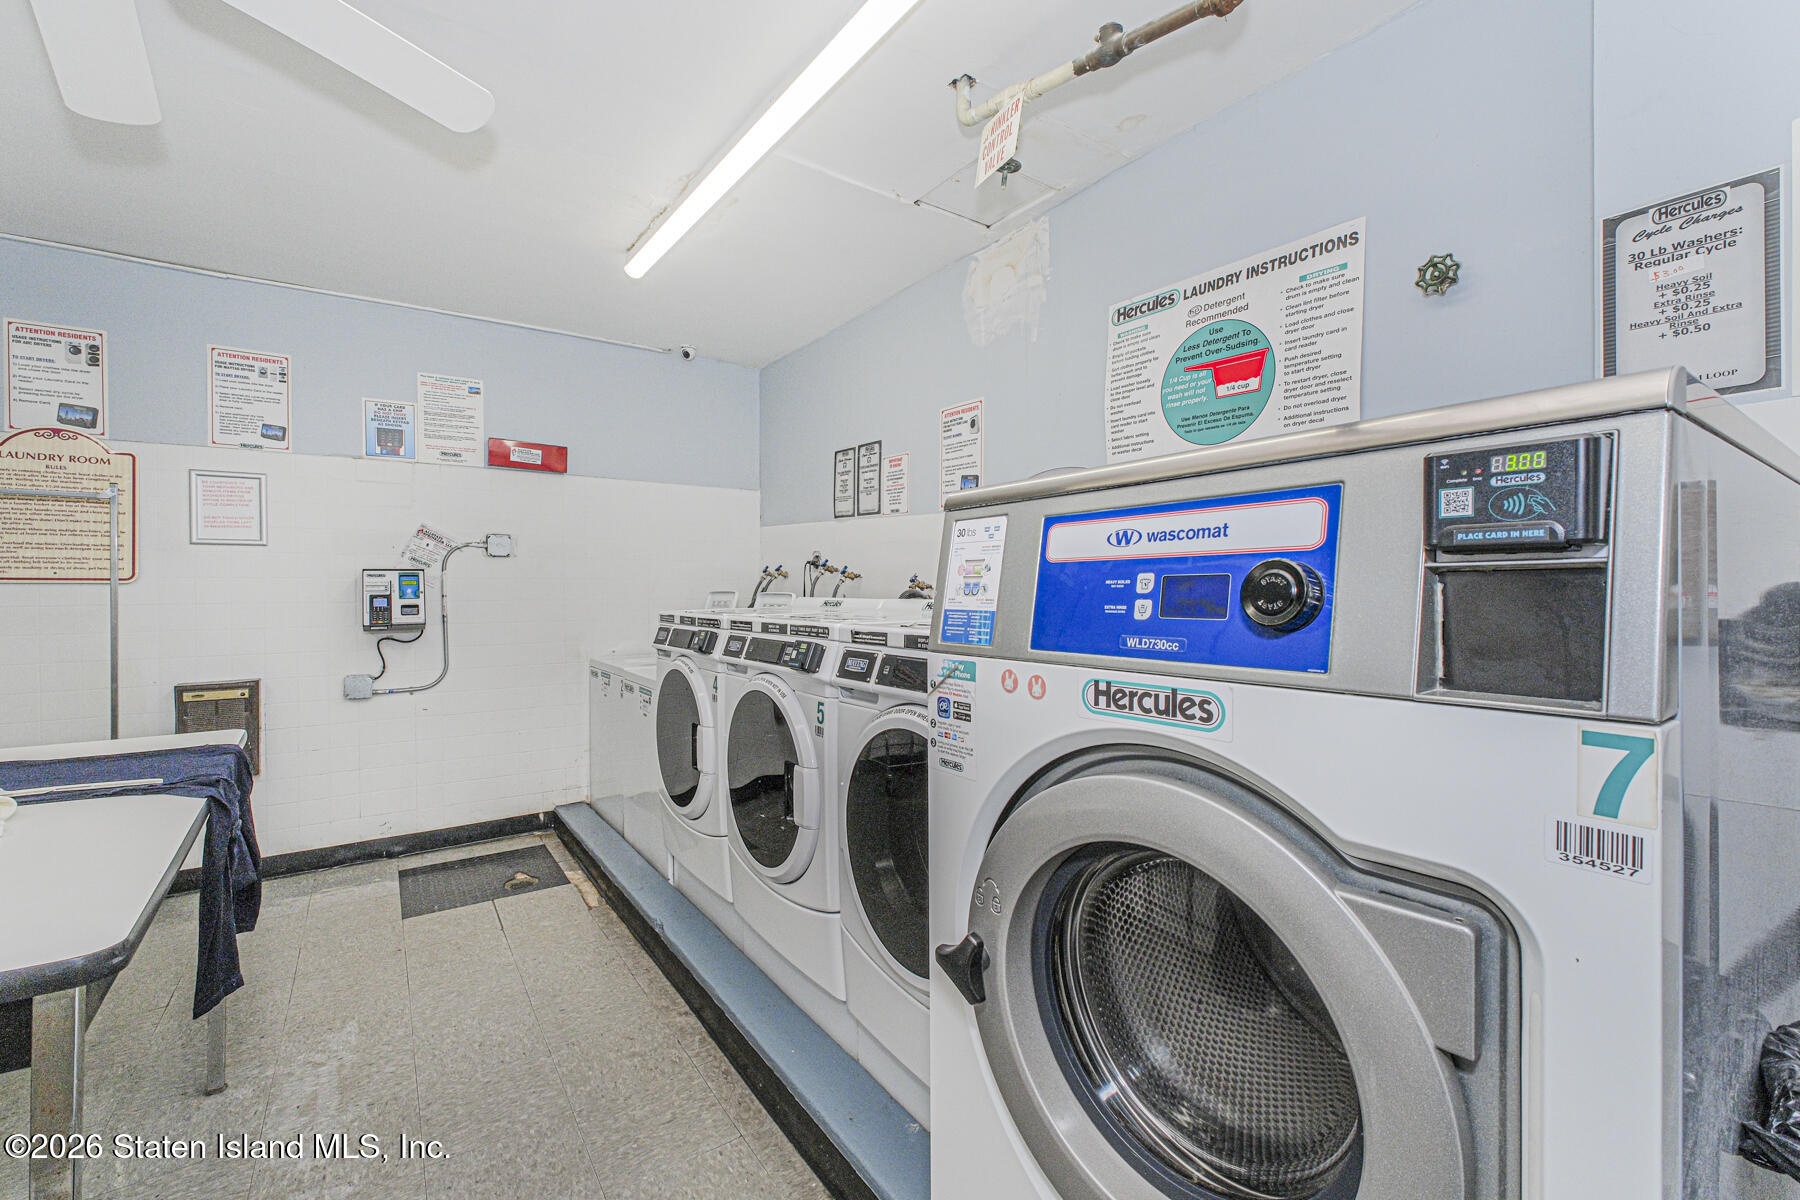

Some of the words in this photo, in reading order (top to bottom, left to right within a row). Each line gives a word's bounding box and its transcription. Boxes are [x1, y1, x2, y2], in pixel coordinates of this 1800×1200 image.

[1657, 193, 1721, 221] Hercules
[1632, 225, 1672, 243] Cycle
[1679, 206, 1743, 230] Charges
[1628, 252, 1646, 262] 30
[1650, 246, 1667, 257] Lb
[1672, 226, 1743, 252] Washers:
[1696, 239, 1737, 255] Cycle
[1116, 292, 1175, 322] Hercules
[1183, 271, 1242, 300] LAUNDRY
[1246, 231, 1359, 279] INSTRUCTIONS
[1656, 277, 1689, 292] Heavy
[1692, 273, 1713, 283] Soil
[1285, 284, 1304, 293] Check
[1308, 285, 1327, 294] empty
[1342, 277, 1360, 285] clean
[1672, 282, 1710, 296] $0.25
[1203, 292, 1245, 312] Detergent
[1329, 291, 1350, 299] before
[1653, 299, 1681, 308] Extra
[1685, 289, 1715, 301] Rinse
[1285, 308, 1307, 317] starting
[1672, 299, 1710, 313] $0.25
[1185, 303, 1248, 328] Recommended
[1285, 320, 1299, 328] Load
[1301, 315, 1322, 324] clothes
[1337, 307, 1354, 315] close
[1630, 319, 1661, 330] Heavy
[1664, 314, 1684, 322] Soil
[1688, 308, 1708, 317] And
[1712, 302, 1743, 312] Extra
[1669, 318, 1699, 328] Rinse
[15, 327, 56, 336] ATTENTION
[58, 331, 96, 341] RESIDENTS
[1673, 323, 1710, 338] $0.50
[1183, 344, 1200, 352] Less
[1203, 332, 1239, 347] Detergent
[217, 352, 250, 360] ATTENTION
[252, 357, 283, 365] RESIDENTS
[1176, 352, 1202, 363] Prevent
[1205, 340, 1260, 356] Over-Sudsing.
[1168, 392, 1182, 400] wash
[0, 451, 65, 462] LAUNDRY
[69, 455, 112, 465] ROOM
[1506, 452, 1545, 471] 3.00
[1495, 473, 1542, 485] Hercules
[957, 528, 966, 537] 30
[967, 528, 976, 537] lbs
[1115, 530, 1135, 546] W
[1146, 523, 1229, 543] wascomat
[1457, 532, 1483, 540] PLACE
[1485, 531, 1508, 539] CARD
[1260, 575, 1287, 586] START
[1257, 599, 1283, 612] START
[1126, 638, 1179, 651] WLD730cc
[713, 676, 718, 693] 4
[1093, 680, 1213, 723] Hercules
[817, 702, 824, 724] 5
[1581, 730, 1654, 819] 7
[1559, 852, 1639, 876] 354527
